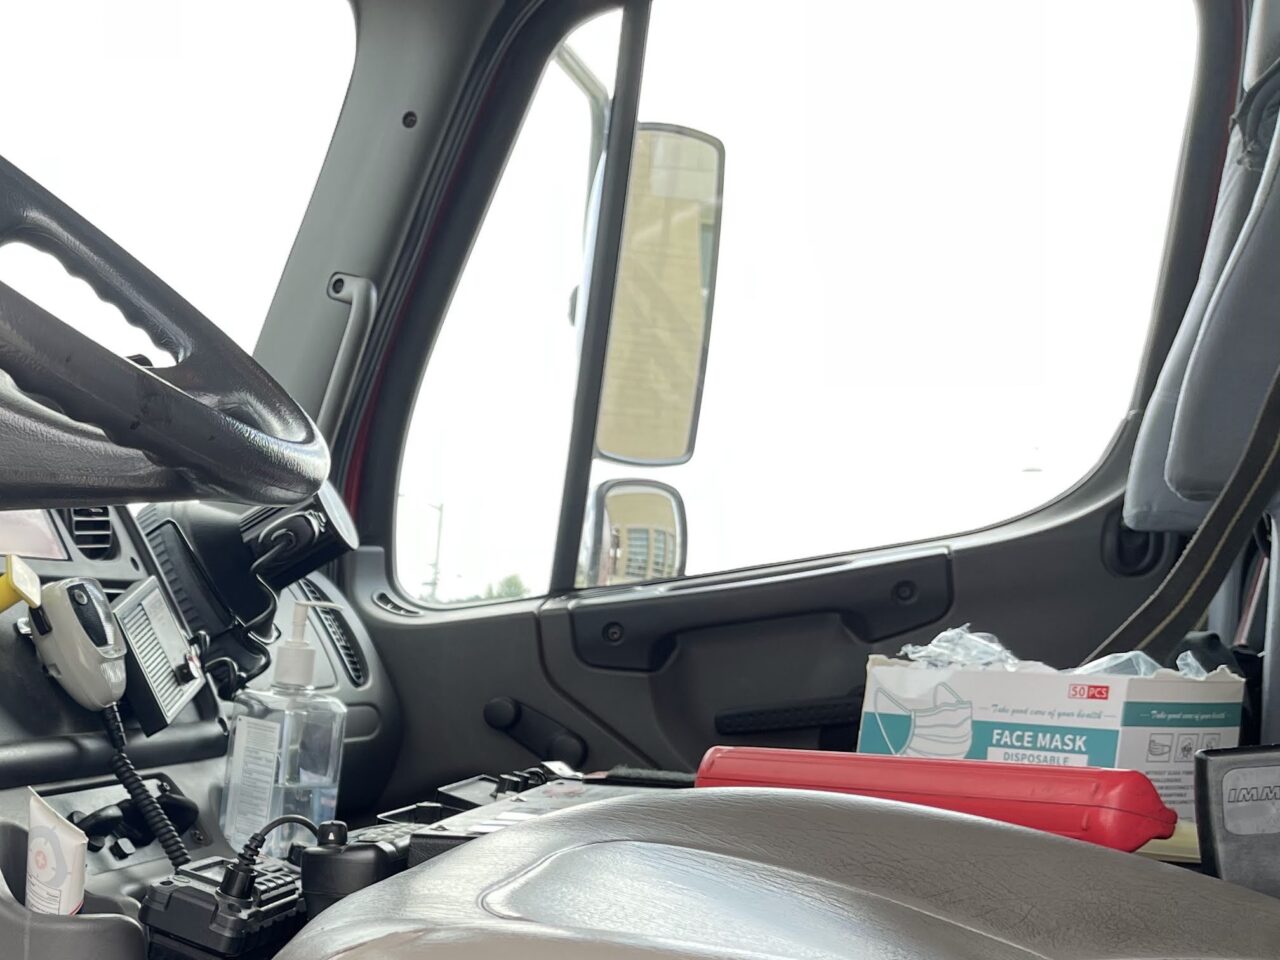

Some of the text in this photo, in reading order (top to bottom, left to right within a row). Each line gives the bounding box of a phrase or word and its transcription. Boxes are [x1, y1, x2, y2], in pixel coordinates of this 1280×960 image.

[1071, 685, 1107, 698] 50 PCS
[991, 704, 1010, 714] Take
[1047, 708, 1057, 719] of
[992, 729, 1088, 752] FACE MASK
[1003, 752, 1070, 766] DISPOSABLE
